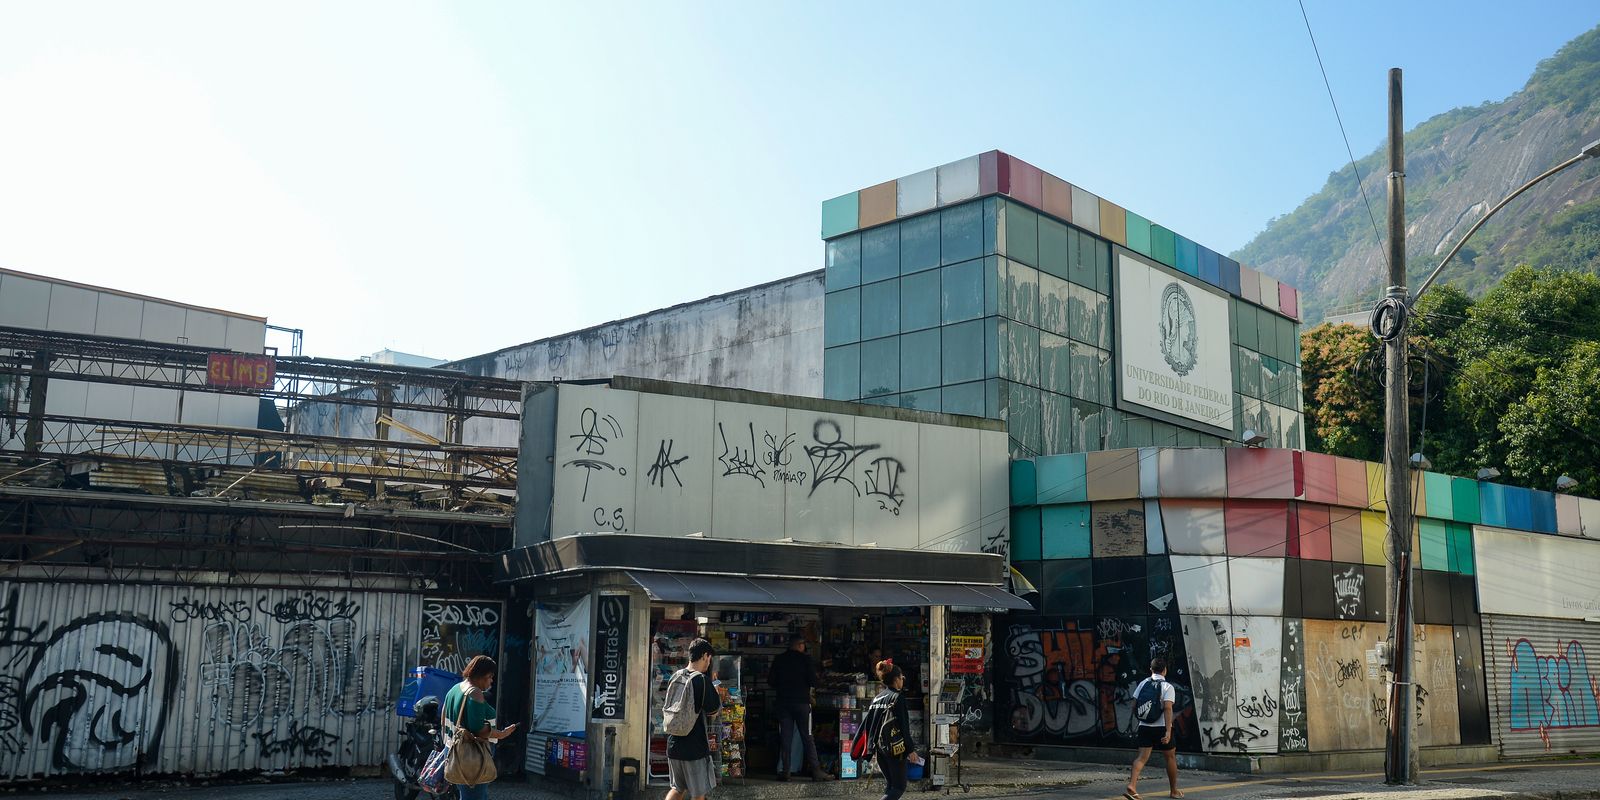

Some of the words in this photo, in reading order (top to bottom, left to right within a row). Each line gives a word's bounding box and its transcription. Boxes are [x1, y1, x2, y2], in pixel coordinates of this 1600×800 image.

[1126, 364, 1192, 395] UNIVERSIDADE
[1193, 384, 1230, 407] FEDERAL
[1138, 386, 1152, 402] DO
[1153, 391, 1169, 407] RIO
[1171, 396, 1184, 411] DE
[1185, 401, 1220, 420] JANEIRO
[602, 626, 619, 717] entreletras
